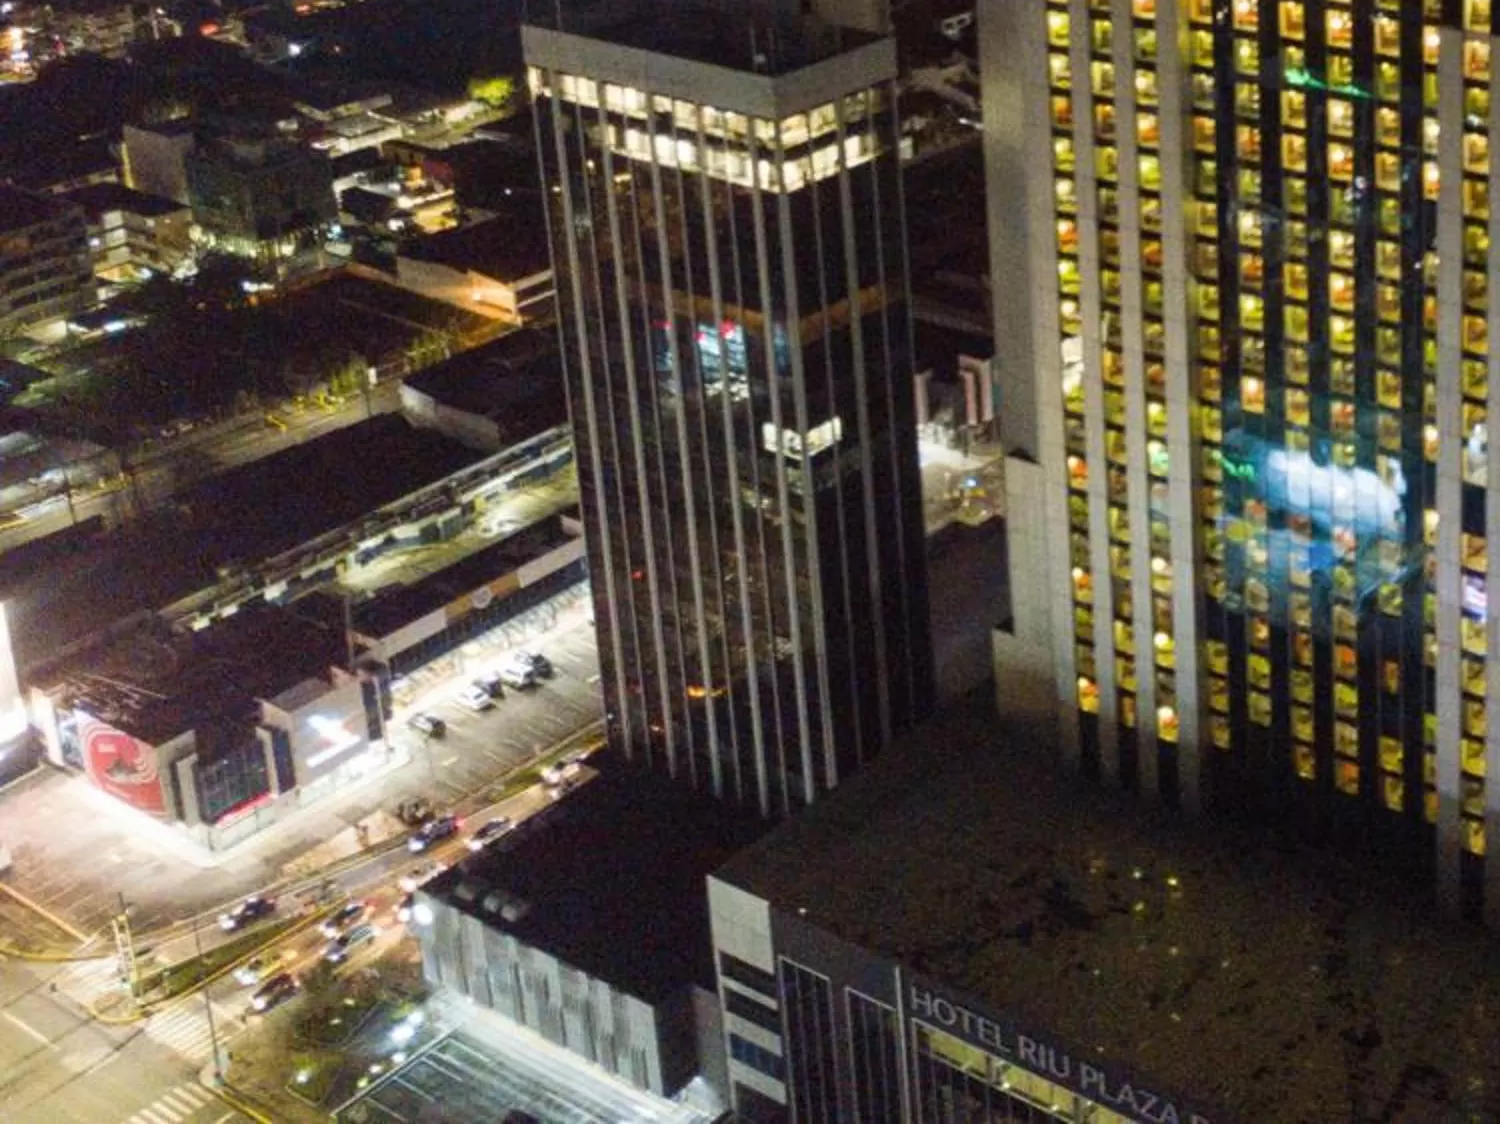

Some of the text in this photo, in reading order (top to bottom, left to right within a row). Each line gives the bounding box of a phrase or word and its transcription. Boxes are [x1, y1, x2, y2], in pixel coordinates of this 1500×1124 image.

[910, 986, 1180, 1124] HOTEL RIU PLAZA
